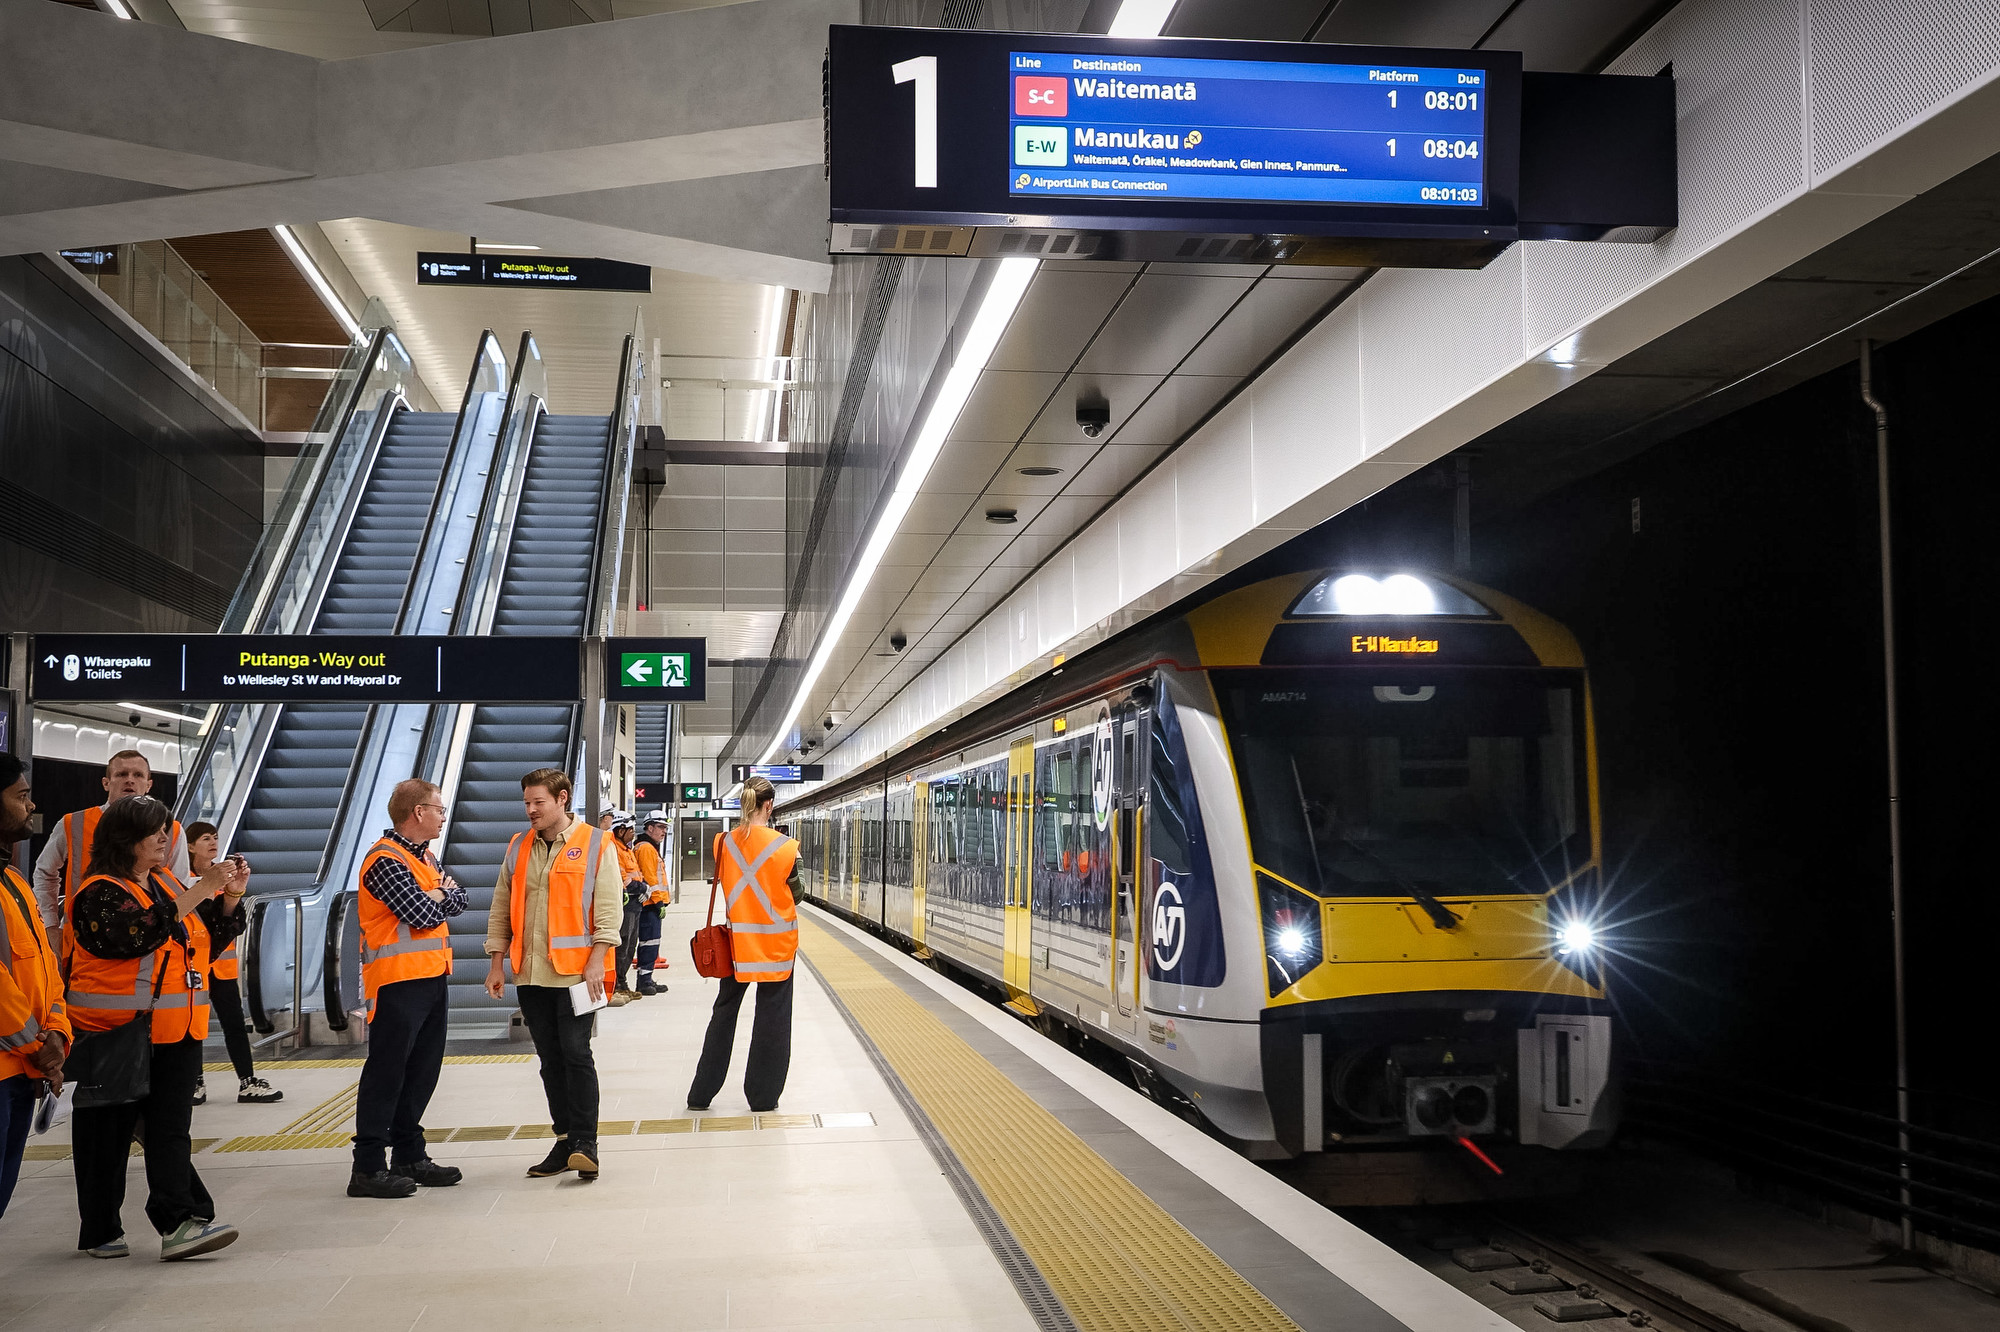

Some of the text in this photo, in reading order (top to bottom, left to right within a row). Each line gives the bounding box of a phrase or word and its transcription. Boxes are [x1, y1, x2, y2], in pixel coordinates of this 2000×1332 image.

[1015, 56, 1481, 85] Line Destination Platform Due
[1028, 77, 1477, 111] S-C Waitematā 1 08:01
[891, 55, 938, 188] 1
[1026, 127, 1479, 159] E-W Manukau 1 08:04
[1073, 154, 1131, 167] Waitematā,
[1170, 157, 1238, 170] Meadowbank,
[1240, 159, 1263, 170] Glen
[1264, 160, 1294, 172] Innes,
[1032, 177, 1168, 191] AirportLink Bus Connection
[1420, 187, 1478, 202] 08:01:03
[501, 262, 534, 273] Putanga
[537, 264, 554, 273] Way
[1378, 635, 1439, 653] Manukau
[84, 656, 152, 669] Wharepaku
[239, 652, 310, 669] Putanga
[318, 652, 354, 669] Way
[358, 653, 386, 667] out
[84, 668, 123, 680] Toilets
[222, 674, 402, 688] to Wellesley St W and Mayoral Dr
[1261, 692, 1307, 702] AMA714
[737, 766, 744, 781] 1
